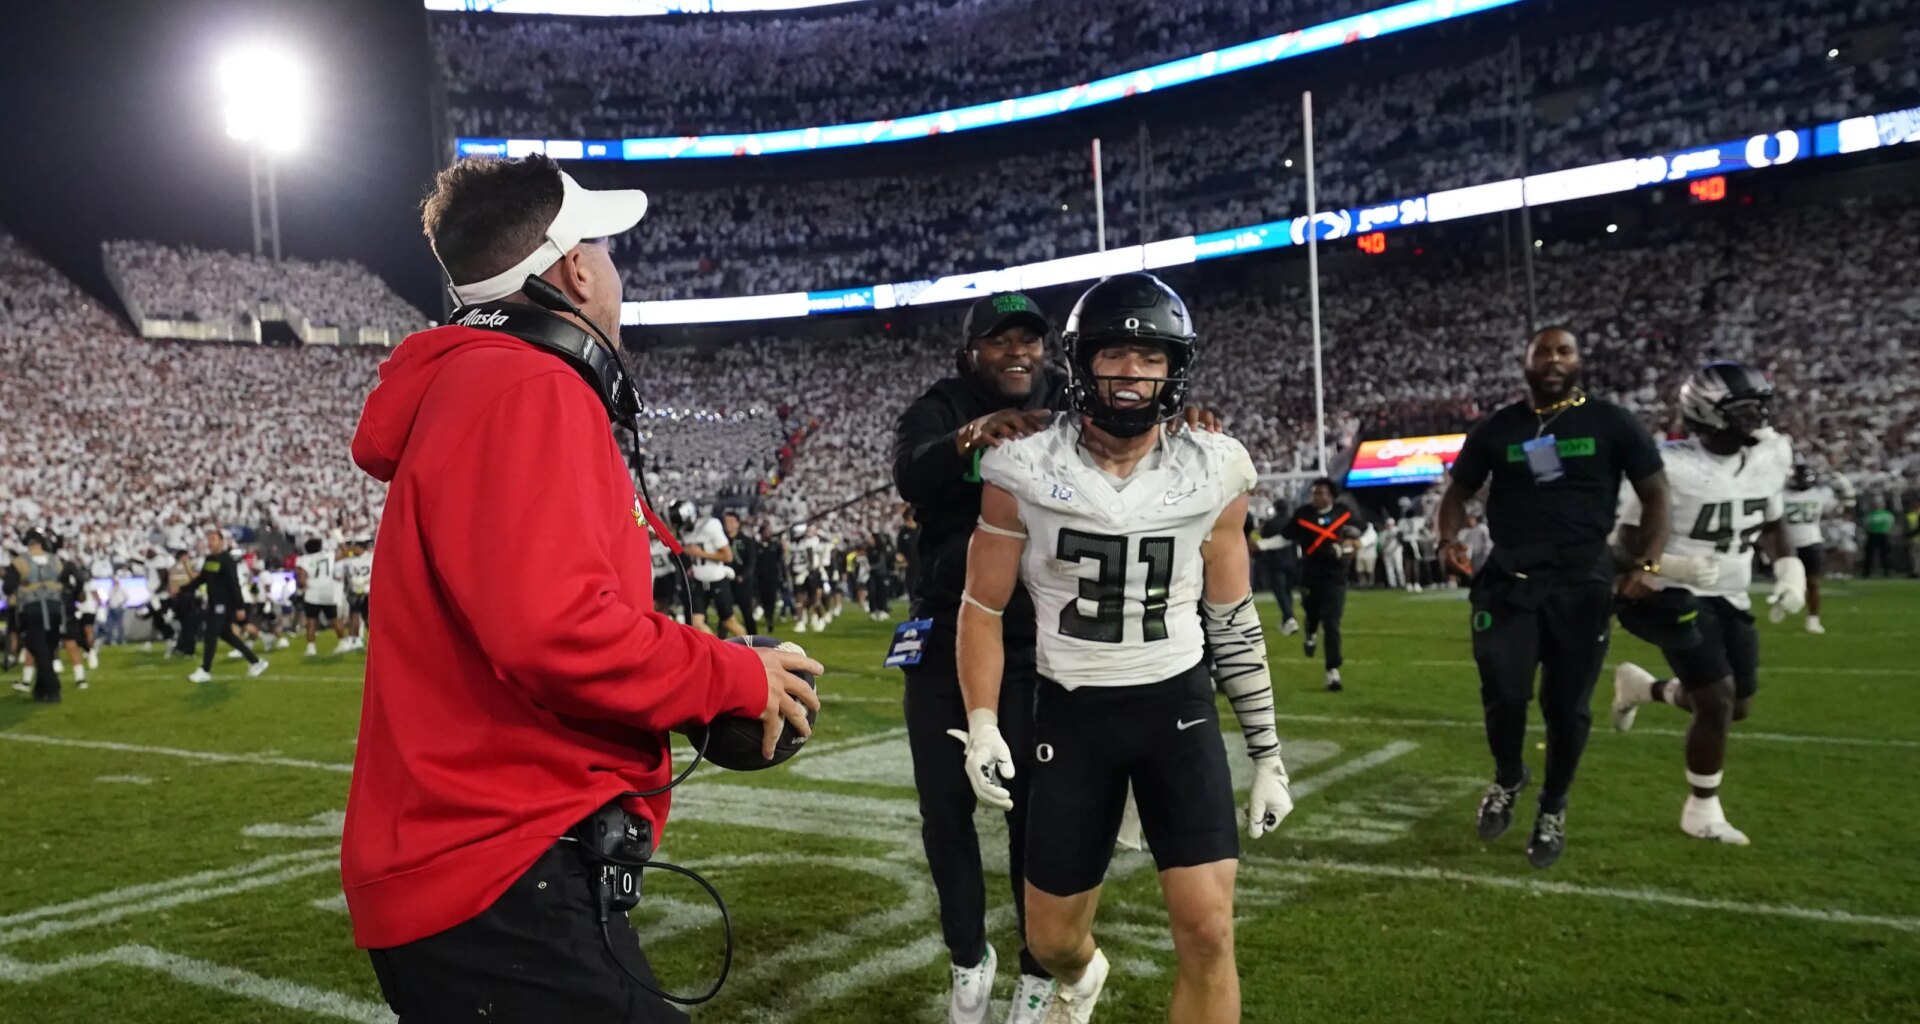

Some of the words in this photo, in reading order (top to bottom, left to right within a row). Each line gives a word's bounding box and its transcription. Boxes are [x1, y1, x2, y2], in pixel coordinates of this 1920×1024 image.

[1690, 176, 1725, 200] 40
[1357, 231, 1385, 254] 40
[456, 308, 509, 328] Alaska
[1125, 317, 1139, 329] O
[1690, 498, 1768, 553] 42
[1056, 527, 1175, 643] 31
[1036, 743, 1054, 762] O
